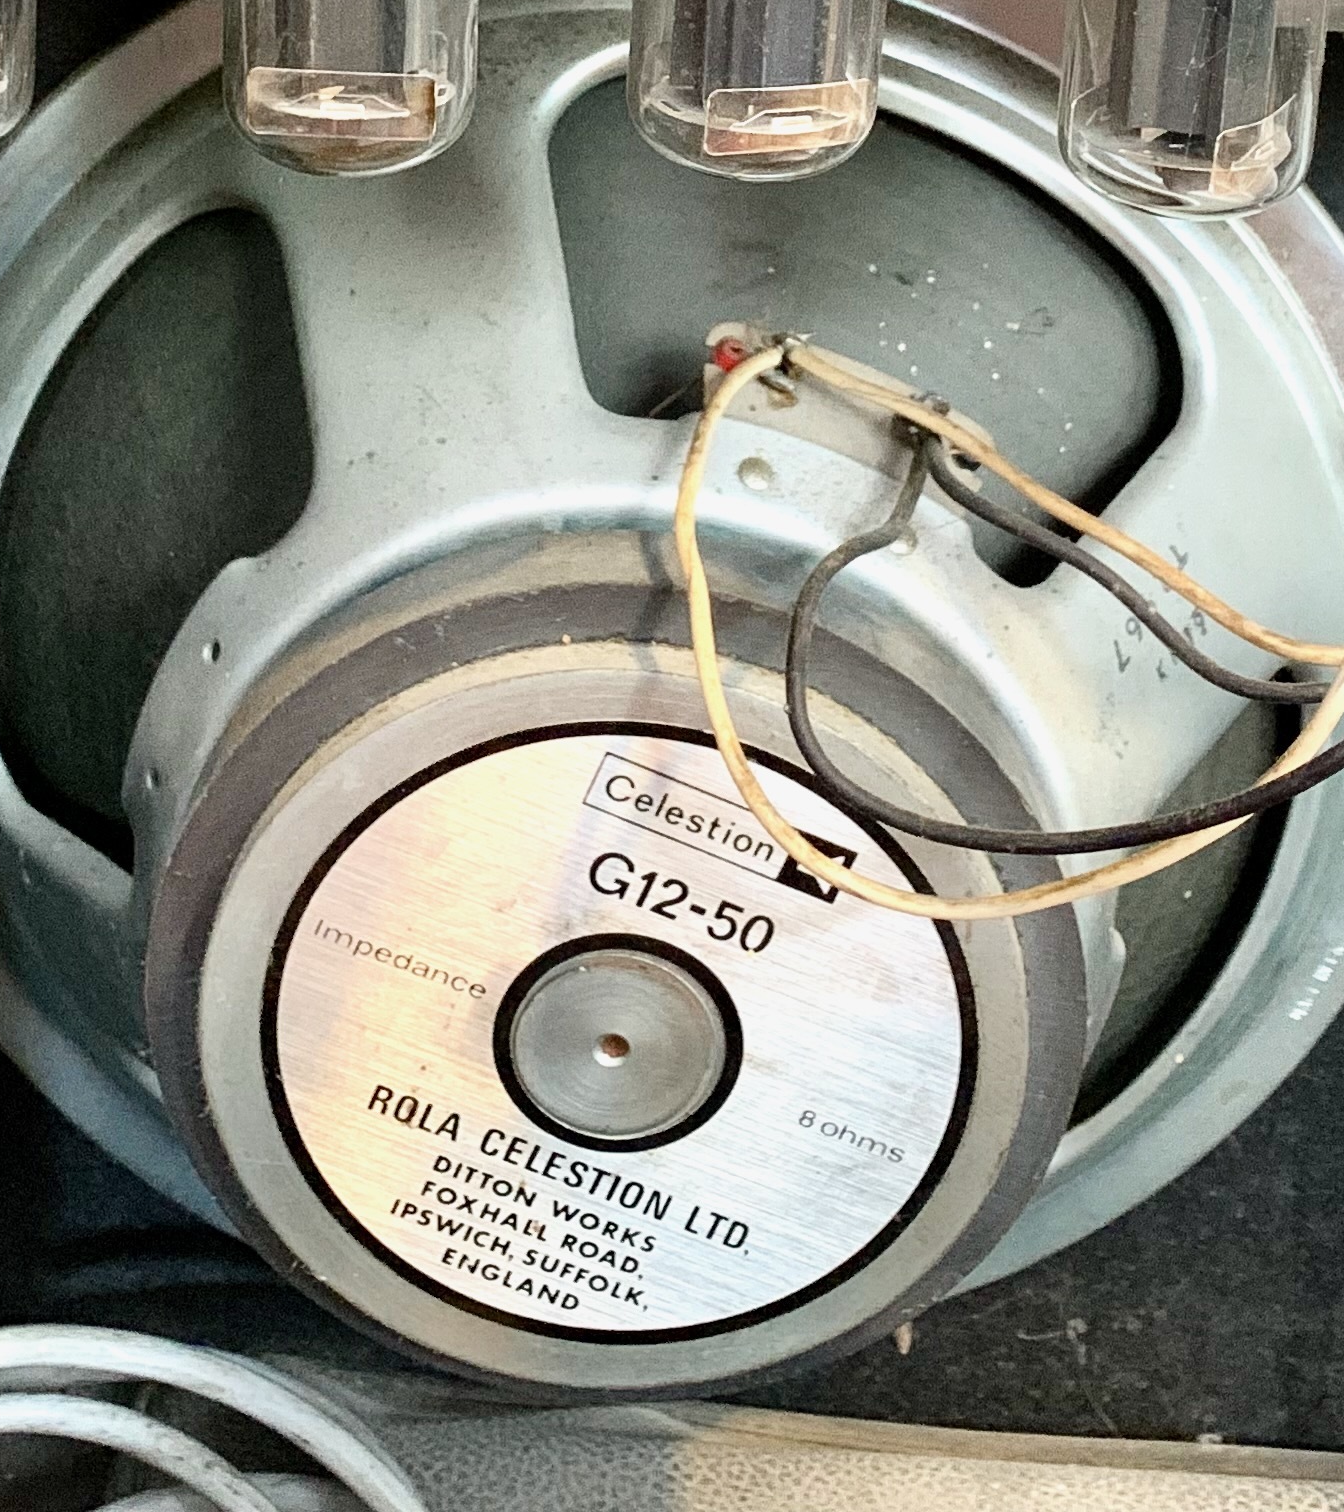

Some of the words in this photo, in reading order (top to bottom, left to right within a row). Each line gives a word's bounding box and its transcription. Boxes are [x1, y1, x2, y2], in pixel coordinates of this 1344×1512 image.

[606, 776, 773, 861] Celestion
[589, 853, 774, 952] G12-50
[315, 920, 486, 998] Impedance
[368, 1085, 459, 1141] ROLA
[480, 1128, 672, 1221] CELESTION
[799, 1110, 816, 1128] 8
[820, 1120, 906, 1163] ohms
[420, 1180, 547, 1243] FOXHALL
[433, 1156, 537, 1207] DITTON
[554, 1200, 656, 1252] WORKS
[442, 1248, 579, 1309] ENGLAND
[523, 1250, 647, 1310] SUFFOLK,
